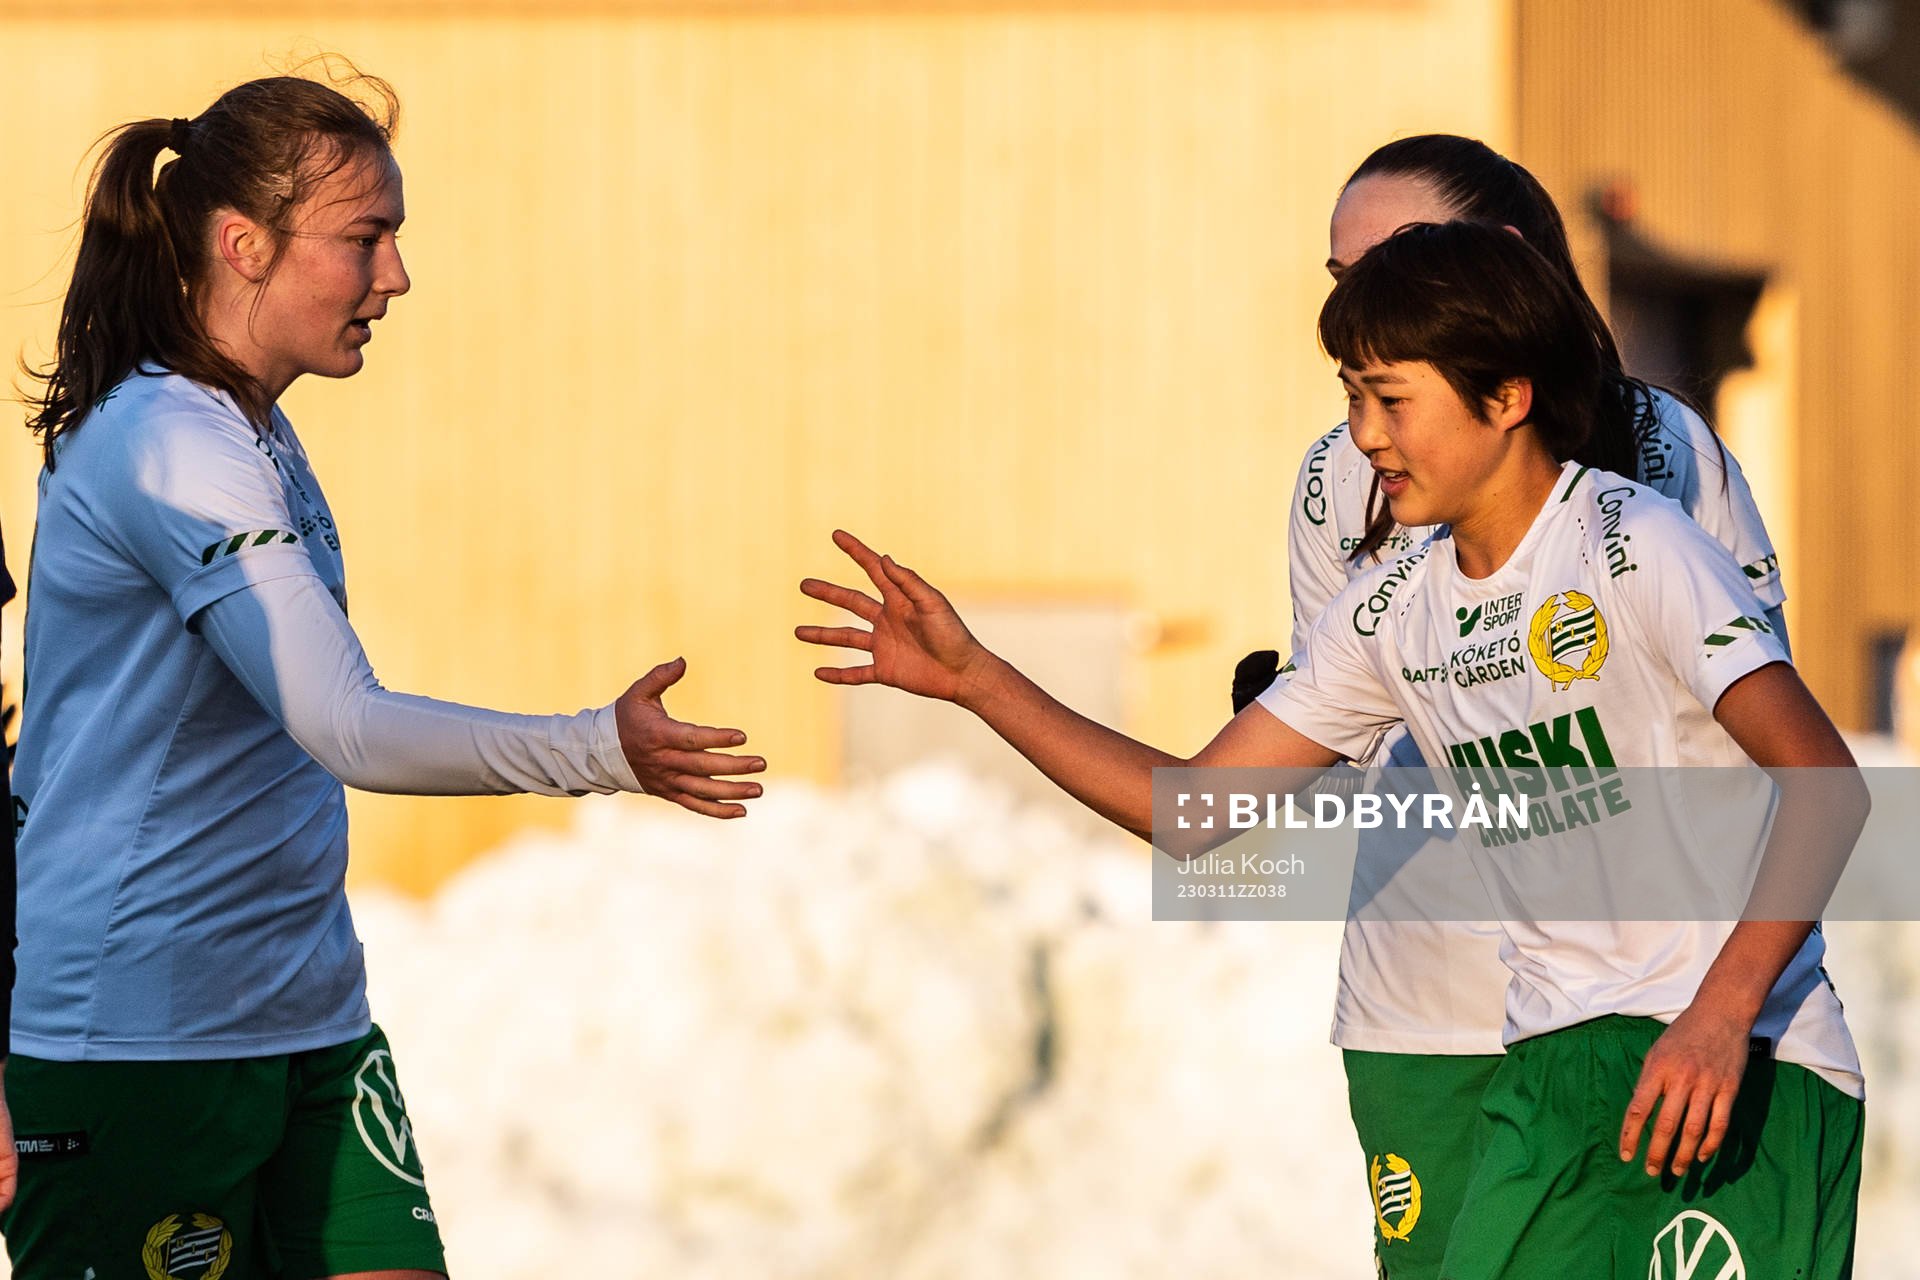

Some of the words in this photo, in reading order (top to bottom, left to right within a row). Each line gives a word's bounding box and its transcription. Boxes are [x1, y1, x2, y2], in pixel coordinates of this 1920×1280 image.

[1303, 421, 1349, 526] Convin
[1597, 487, 1637, 579] Convini
[1483, 607, 1522, 632] SPORT
[1484, 592, 1523, 616] INTER
[1454, 656, 1526, 688] GÅRDEN
